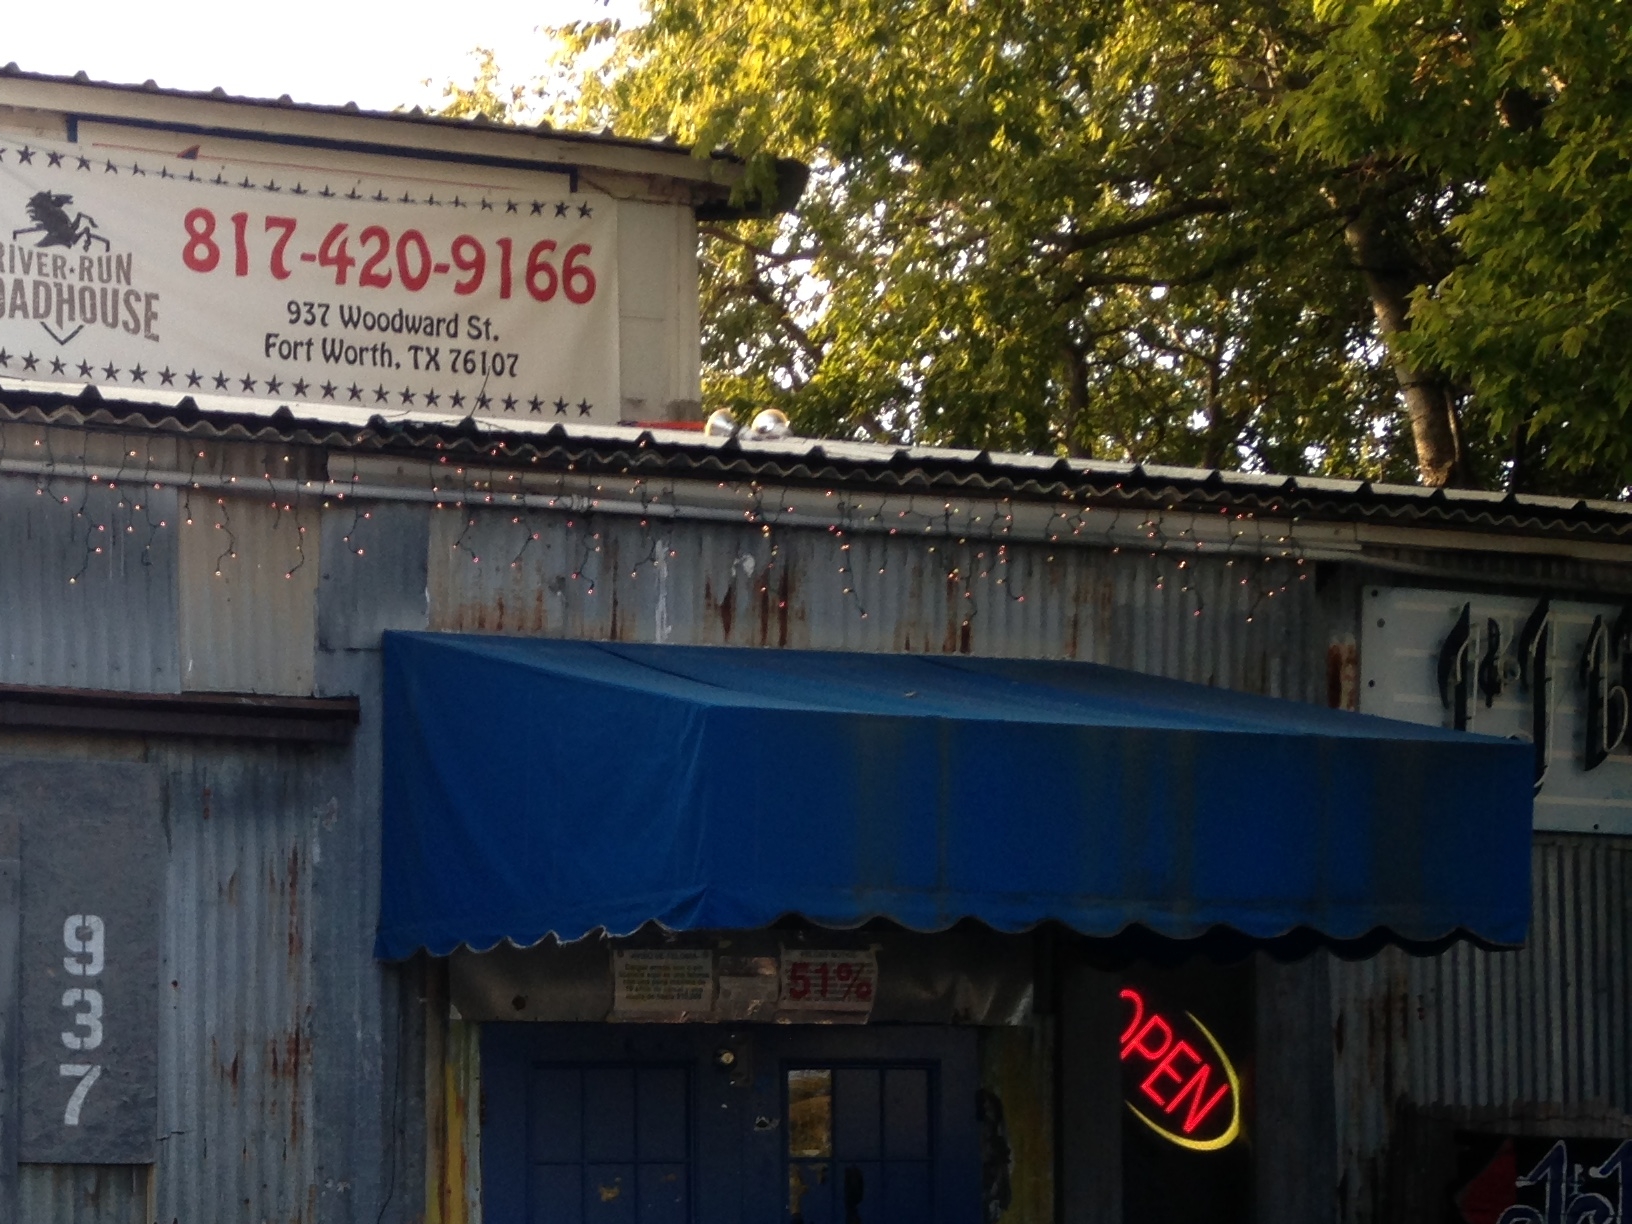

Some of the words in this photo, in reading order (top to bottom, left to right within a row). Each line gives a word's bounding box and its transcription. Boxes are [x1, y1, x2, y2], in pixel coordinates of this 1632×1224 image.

[79, 252, 132, 286] RUN
[182, 207, 597, 305] 817-420-9166
[287, 300, 330, 327] 937
[339, 304, 459, 339] Woodward
[467, 315, 499, 342] St.
[264, 332, 314, 362] Fort
[321, 337, 401, 370] Worth,
[407, 345, 441, 371] TX
[449, 349, 519, 378] 76107
[788, 961, 872, 1000] 51%
[60, 914, 106, 1126] 937
